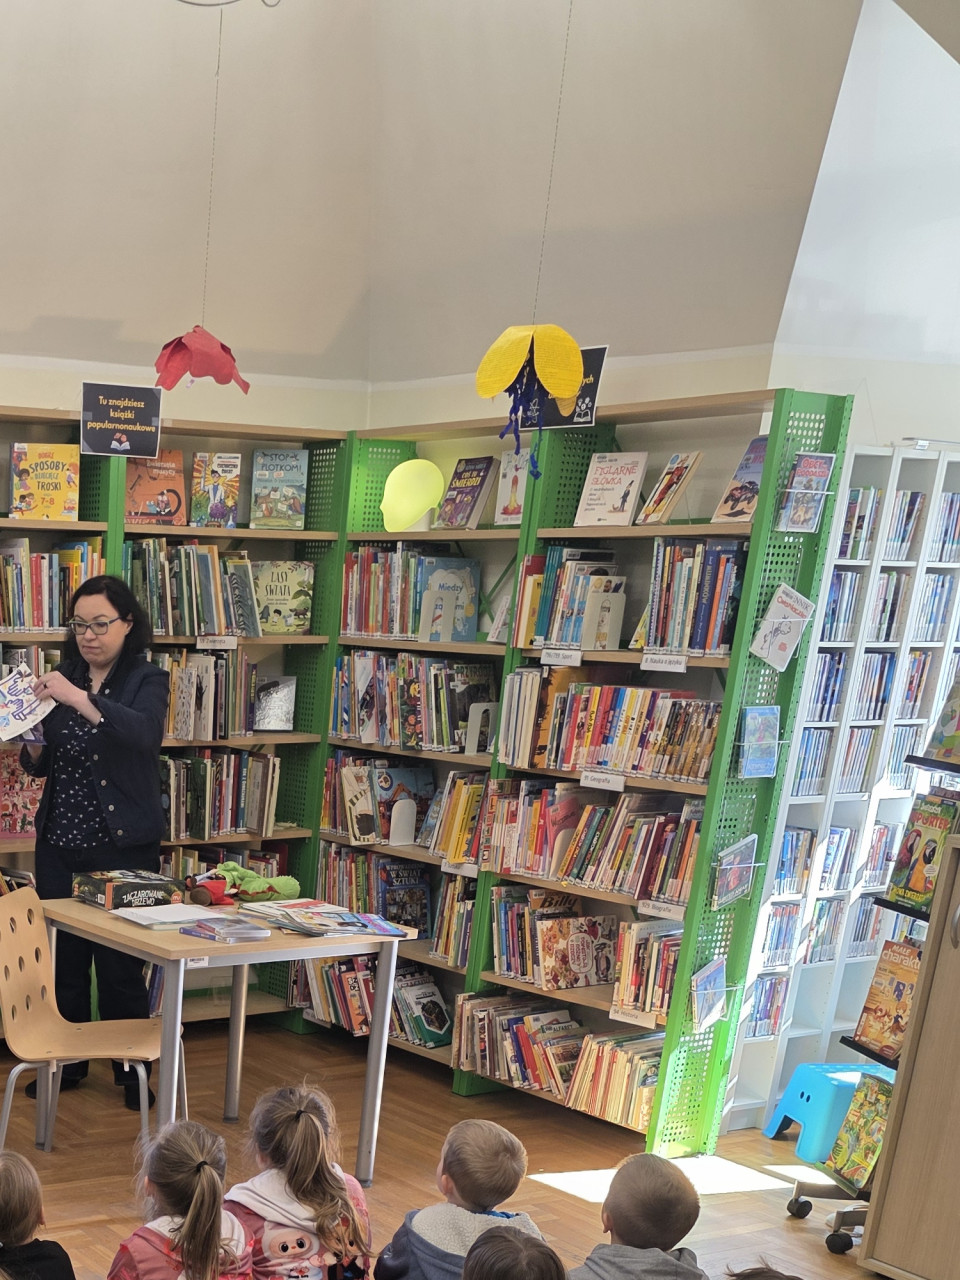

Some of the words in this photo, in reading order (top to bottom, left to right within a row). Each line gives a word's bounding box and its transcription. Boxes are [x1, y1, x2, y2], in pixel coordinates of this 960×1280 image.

[99, 395, 108, 405] Tu
[108, 398, 145, 408] znajdziesz
[109, 408, 135, 420] książki
[87, 420, 156, 432] popularnonaukowe
[270, 453, 289, 462] STOP
[29, 460, 67, 473] SPOSOBY
[261, 463, 302, 472] PLOTKOM!
[594, 465, 638, 475] FIGLARNE
[591, 476, 622, 485] SŁÓWKA
[37, 481, 61, 491] TROSKI
[41, 497, 55, 505] 7-8
[271, 571, 288, 583] LASY
[667, 659, 682, 667] języku
[590, 775, 611, 785] Geografia
[398, 868, 421, 878] ŚWIAT
[392, 877, 419, 886] SZTUKI
[122, 889, 165, 903] ZACZAROWANE
[131, 897, 156, 907] DRZEWO
[540, 894, 577, 909] Billy
[651, 903, 672, 913] Biografie
[620, 1010, 639, 1020] Historia
